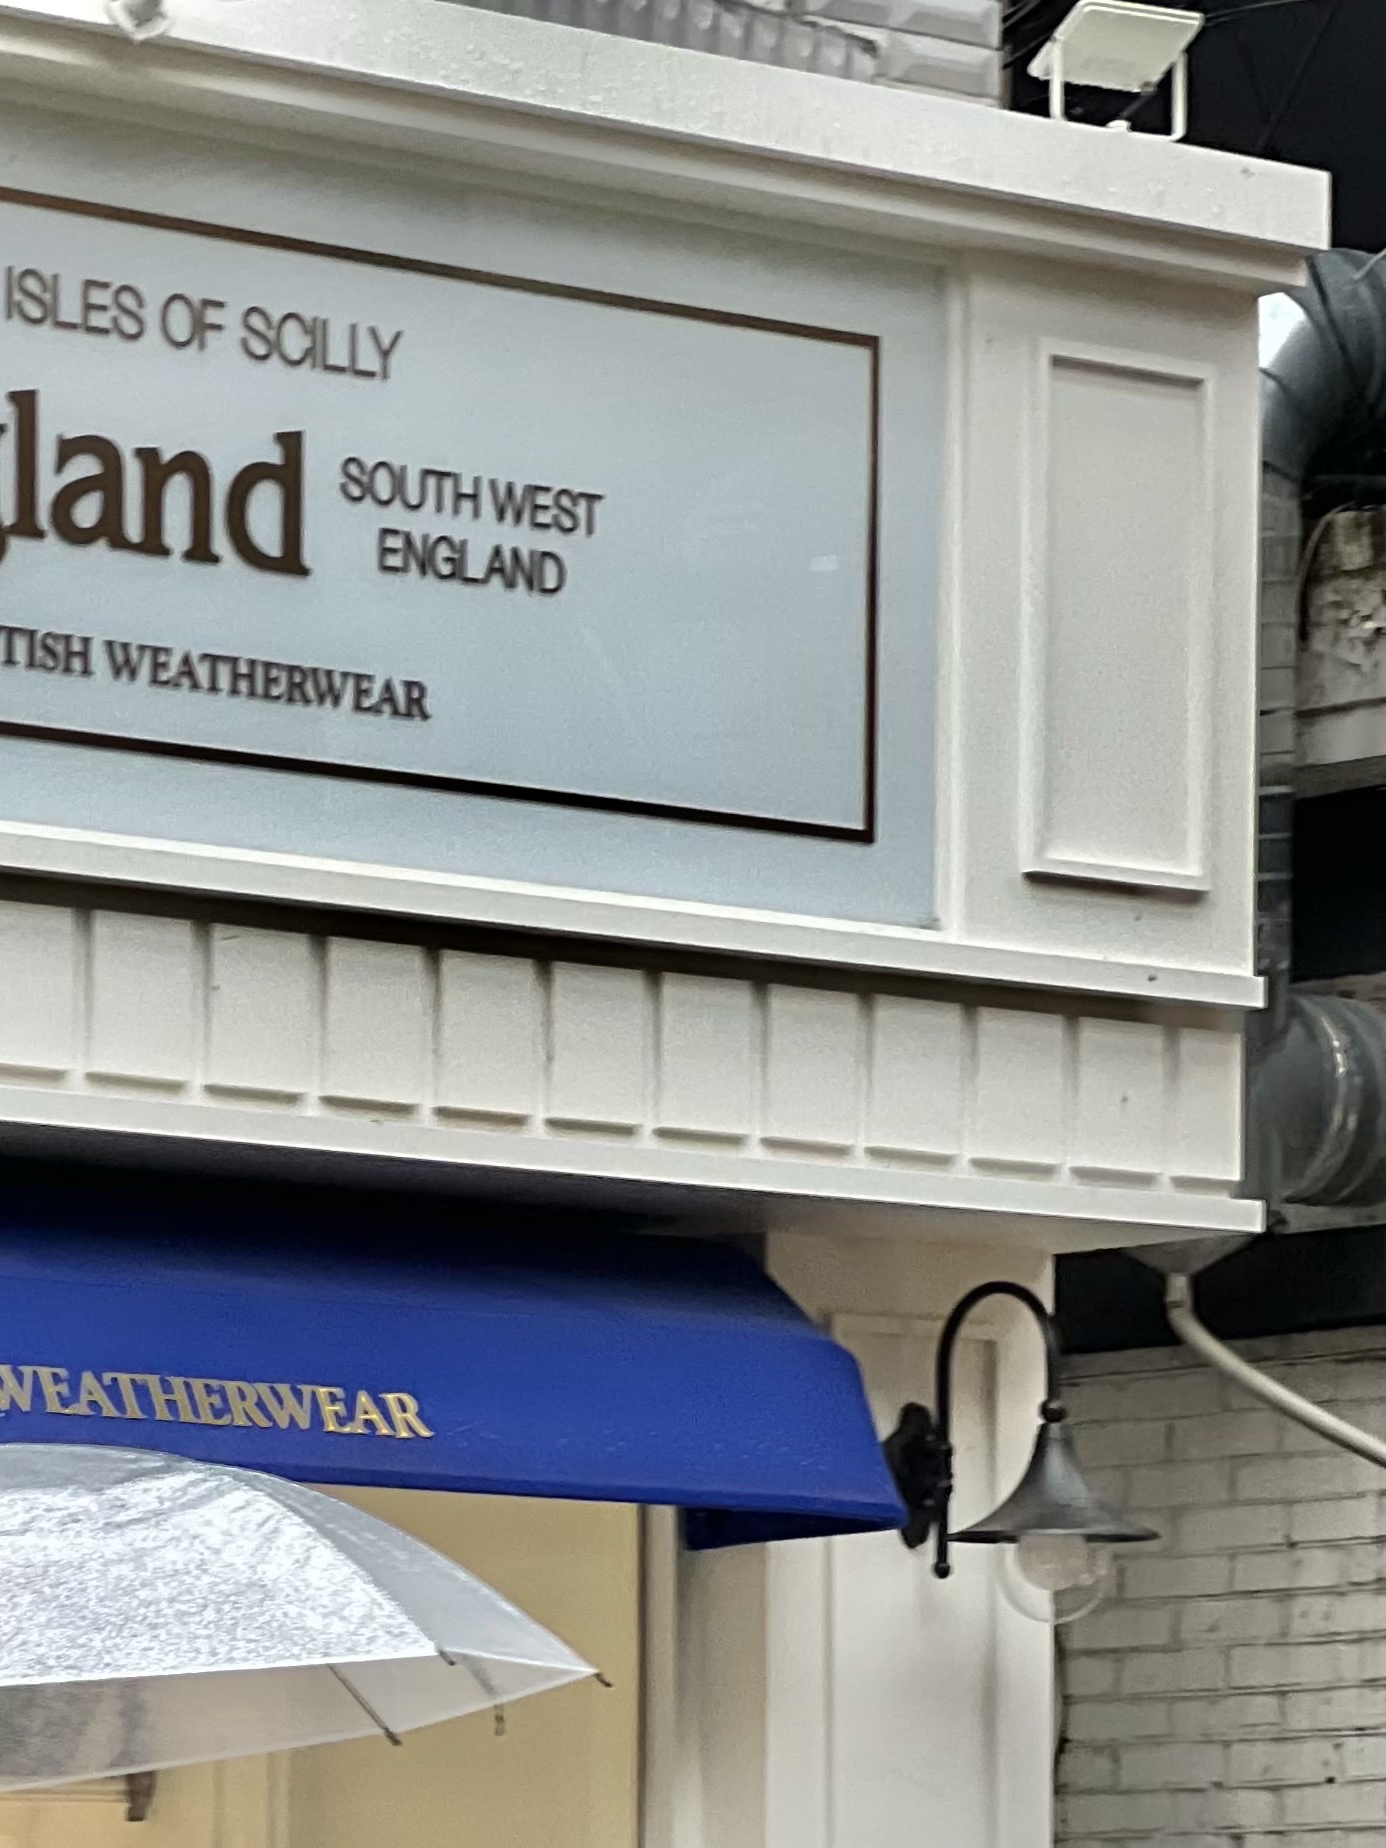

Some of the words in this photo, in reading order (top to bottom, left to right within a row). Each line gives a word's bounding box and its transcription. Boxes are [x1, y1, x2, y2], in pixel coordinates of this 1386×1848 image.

[5, 265, 145, 341] ISLES
[161, 292, 225, 352] OF
[241, 305, 403, 381] SCILLY
[339, 456, 481, 519] SOUTH
[495, 479, 605, 537] WEST
[377, 529, 567, 595] ENGLAND
[104, 640, 432, 723] WEATHERWEAR
